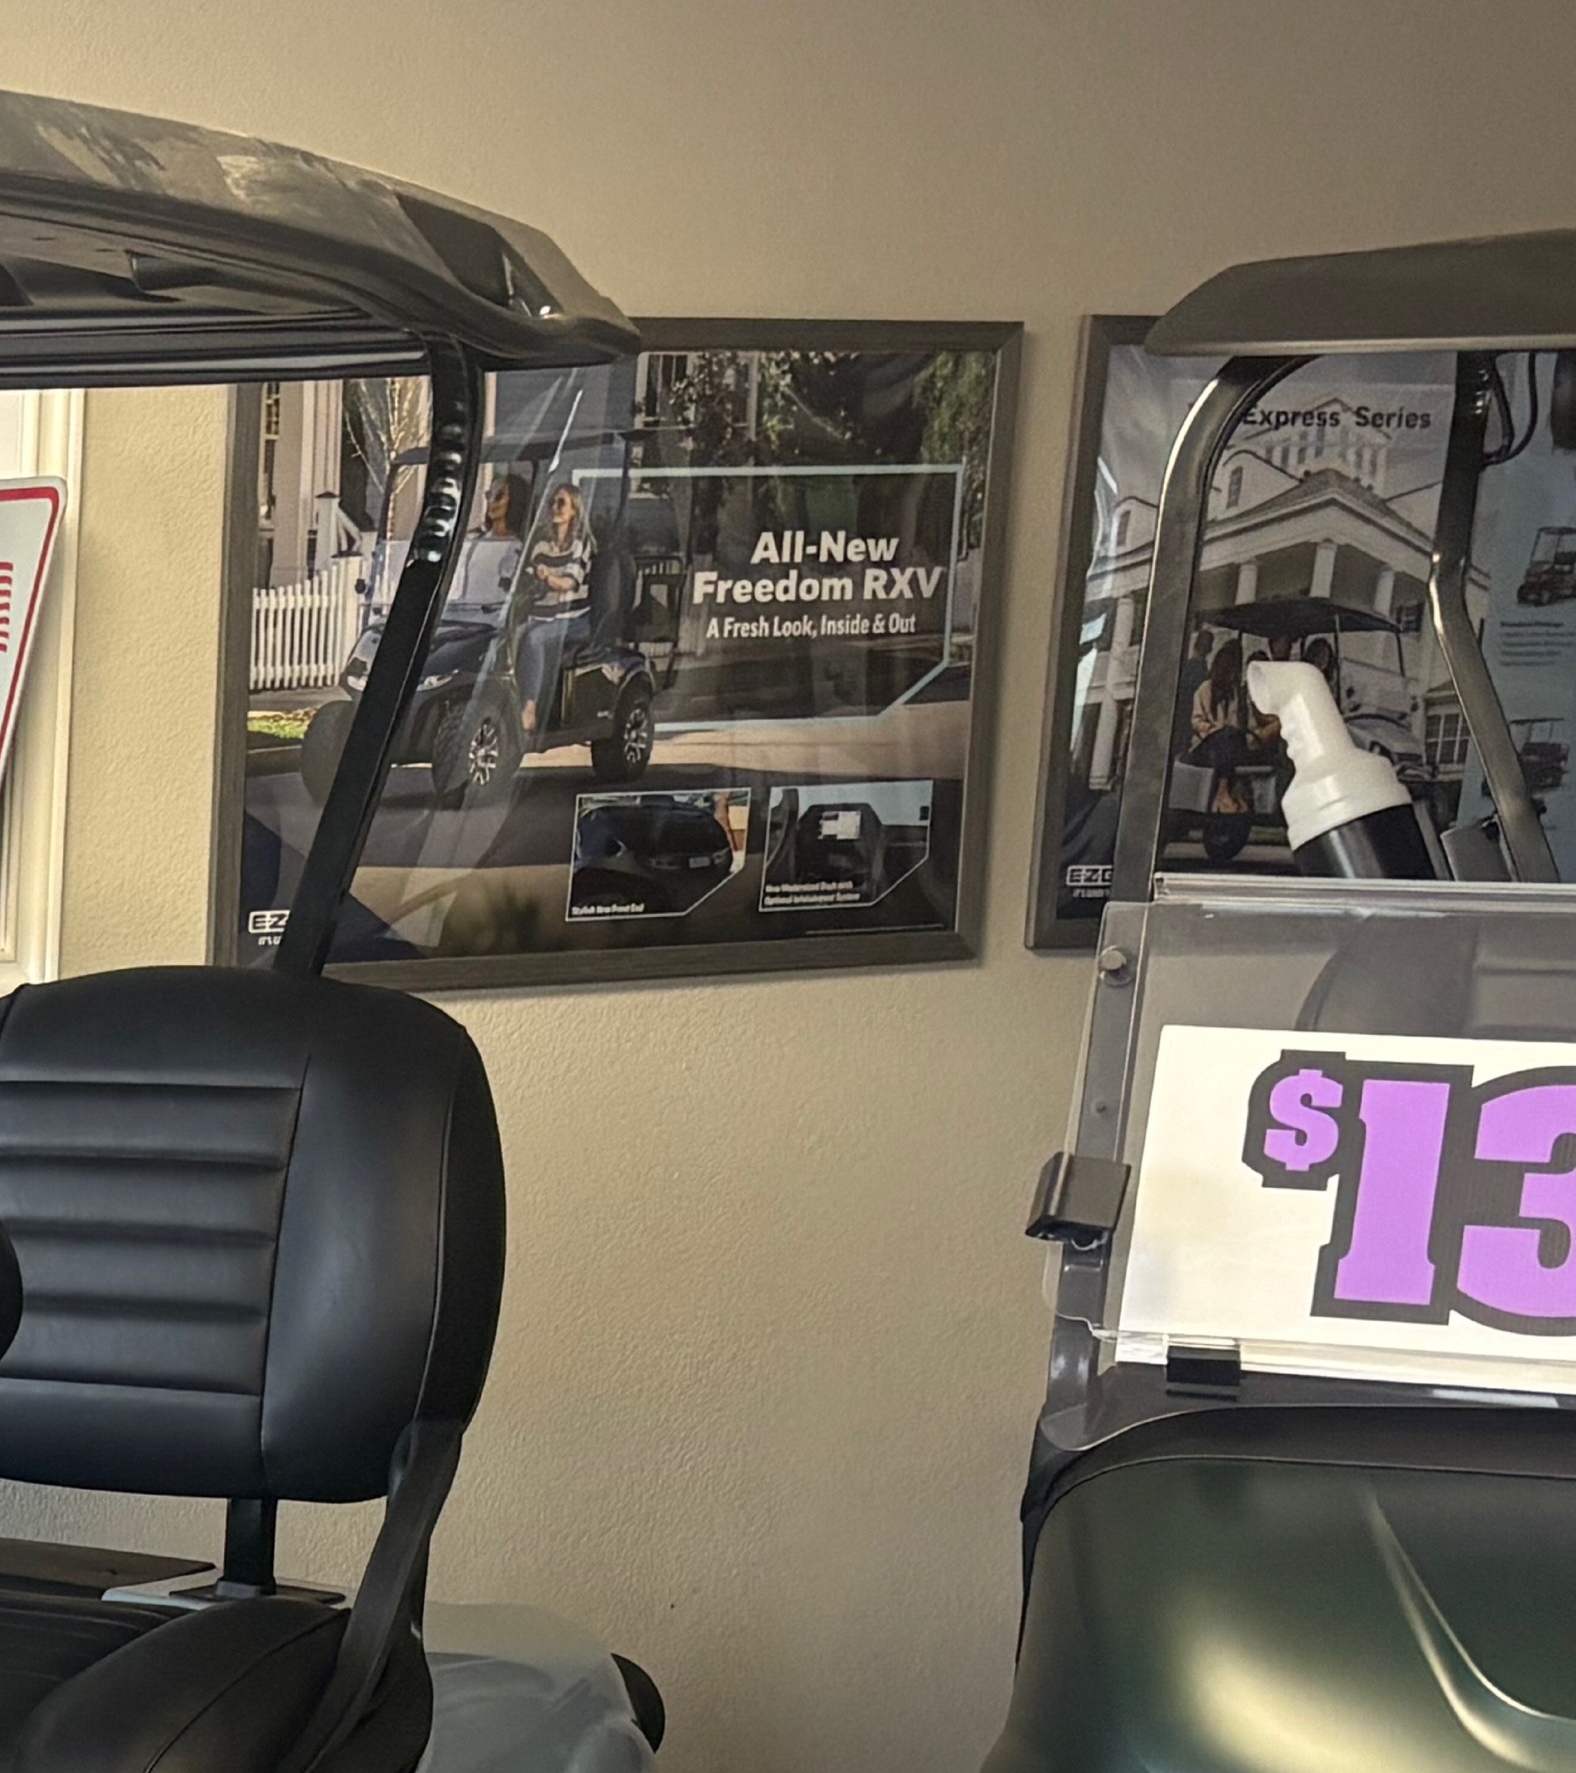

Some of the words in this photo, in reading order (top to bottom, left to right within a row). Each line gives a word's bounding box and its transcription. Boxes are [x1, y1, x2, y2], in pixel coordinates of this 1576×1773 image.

[1355, 405, 1432, 429] Series
[750, 530, 900, 564] All-New
[692, 569, 854, 604] Freedom
[863, 565, 943, 600] RXV
[706, 617, 720, 638] A
[723, 615, 769, 638] Fresh
[773, 614, 818, 639] Look,
[821, 613, 869, 635] Inside
[872, 613, 885, 634] &
[888, 612, 916, 633] Out
